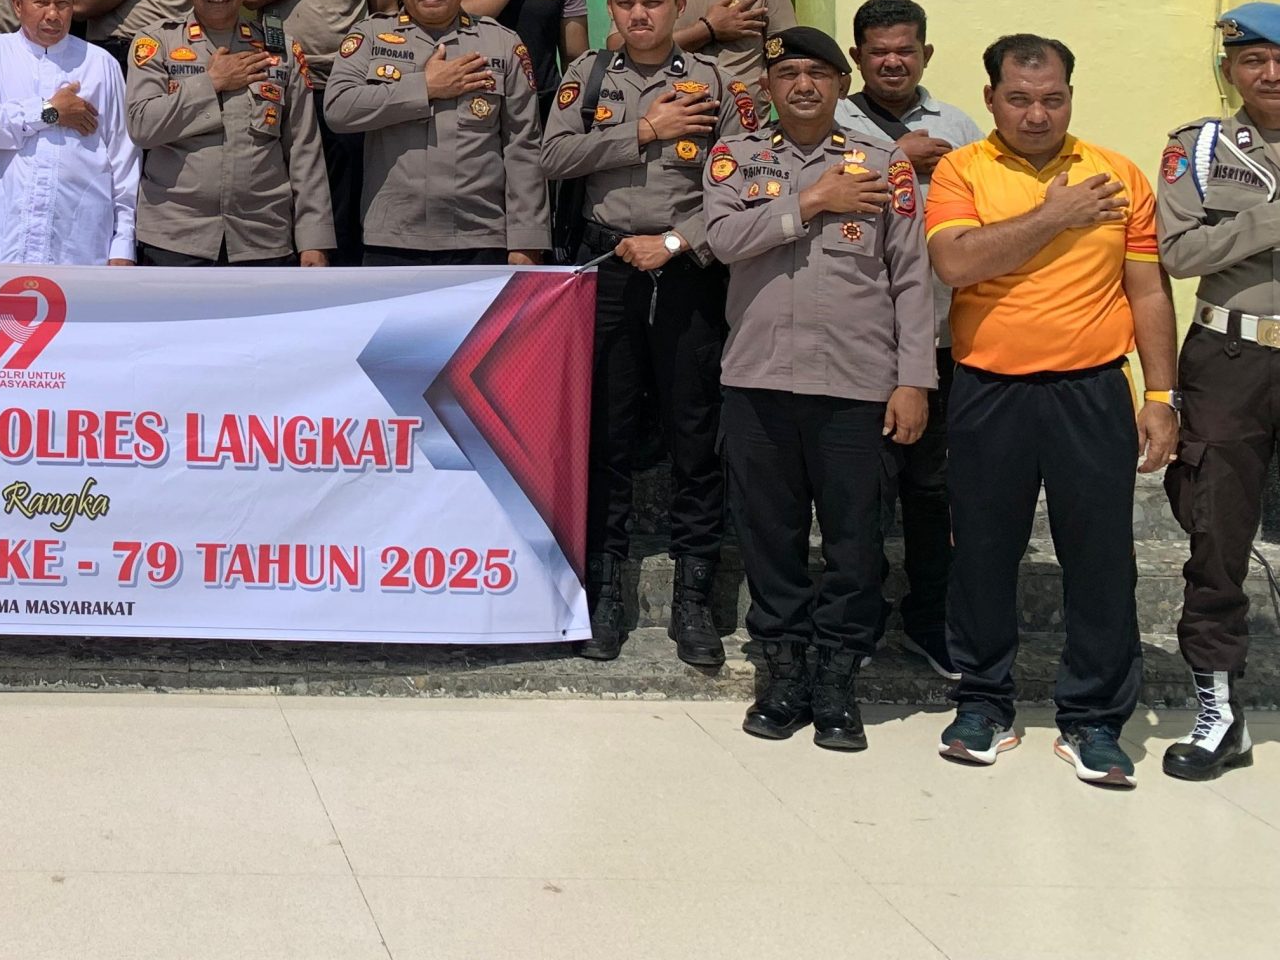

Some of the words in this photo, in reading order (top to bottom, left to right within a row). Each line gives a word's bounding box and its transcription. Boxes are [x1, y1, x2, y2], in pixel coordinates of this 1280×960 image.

[27, 371, 67, 381] UNTUK
[185, 411, 422, 470] LANGKAT
[1, 477, 111, 532] Rangka
[111, 540, 181, 585] 79
[195, 542, 363, 590] TAHUN
[378, 546, 517, 593] 2025
[24, 597, 137, 617] MASYARAKAT
